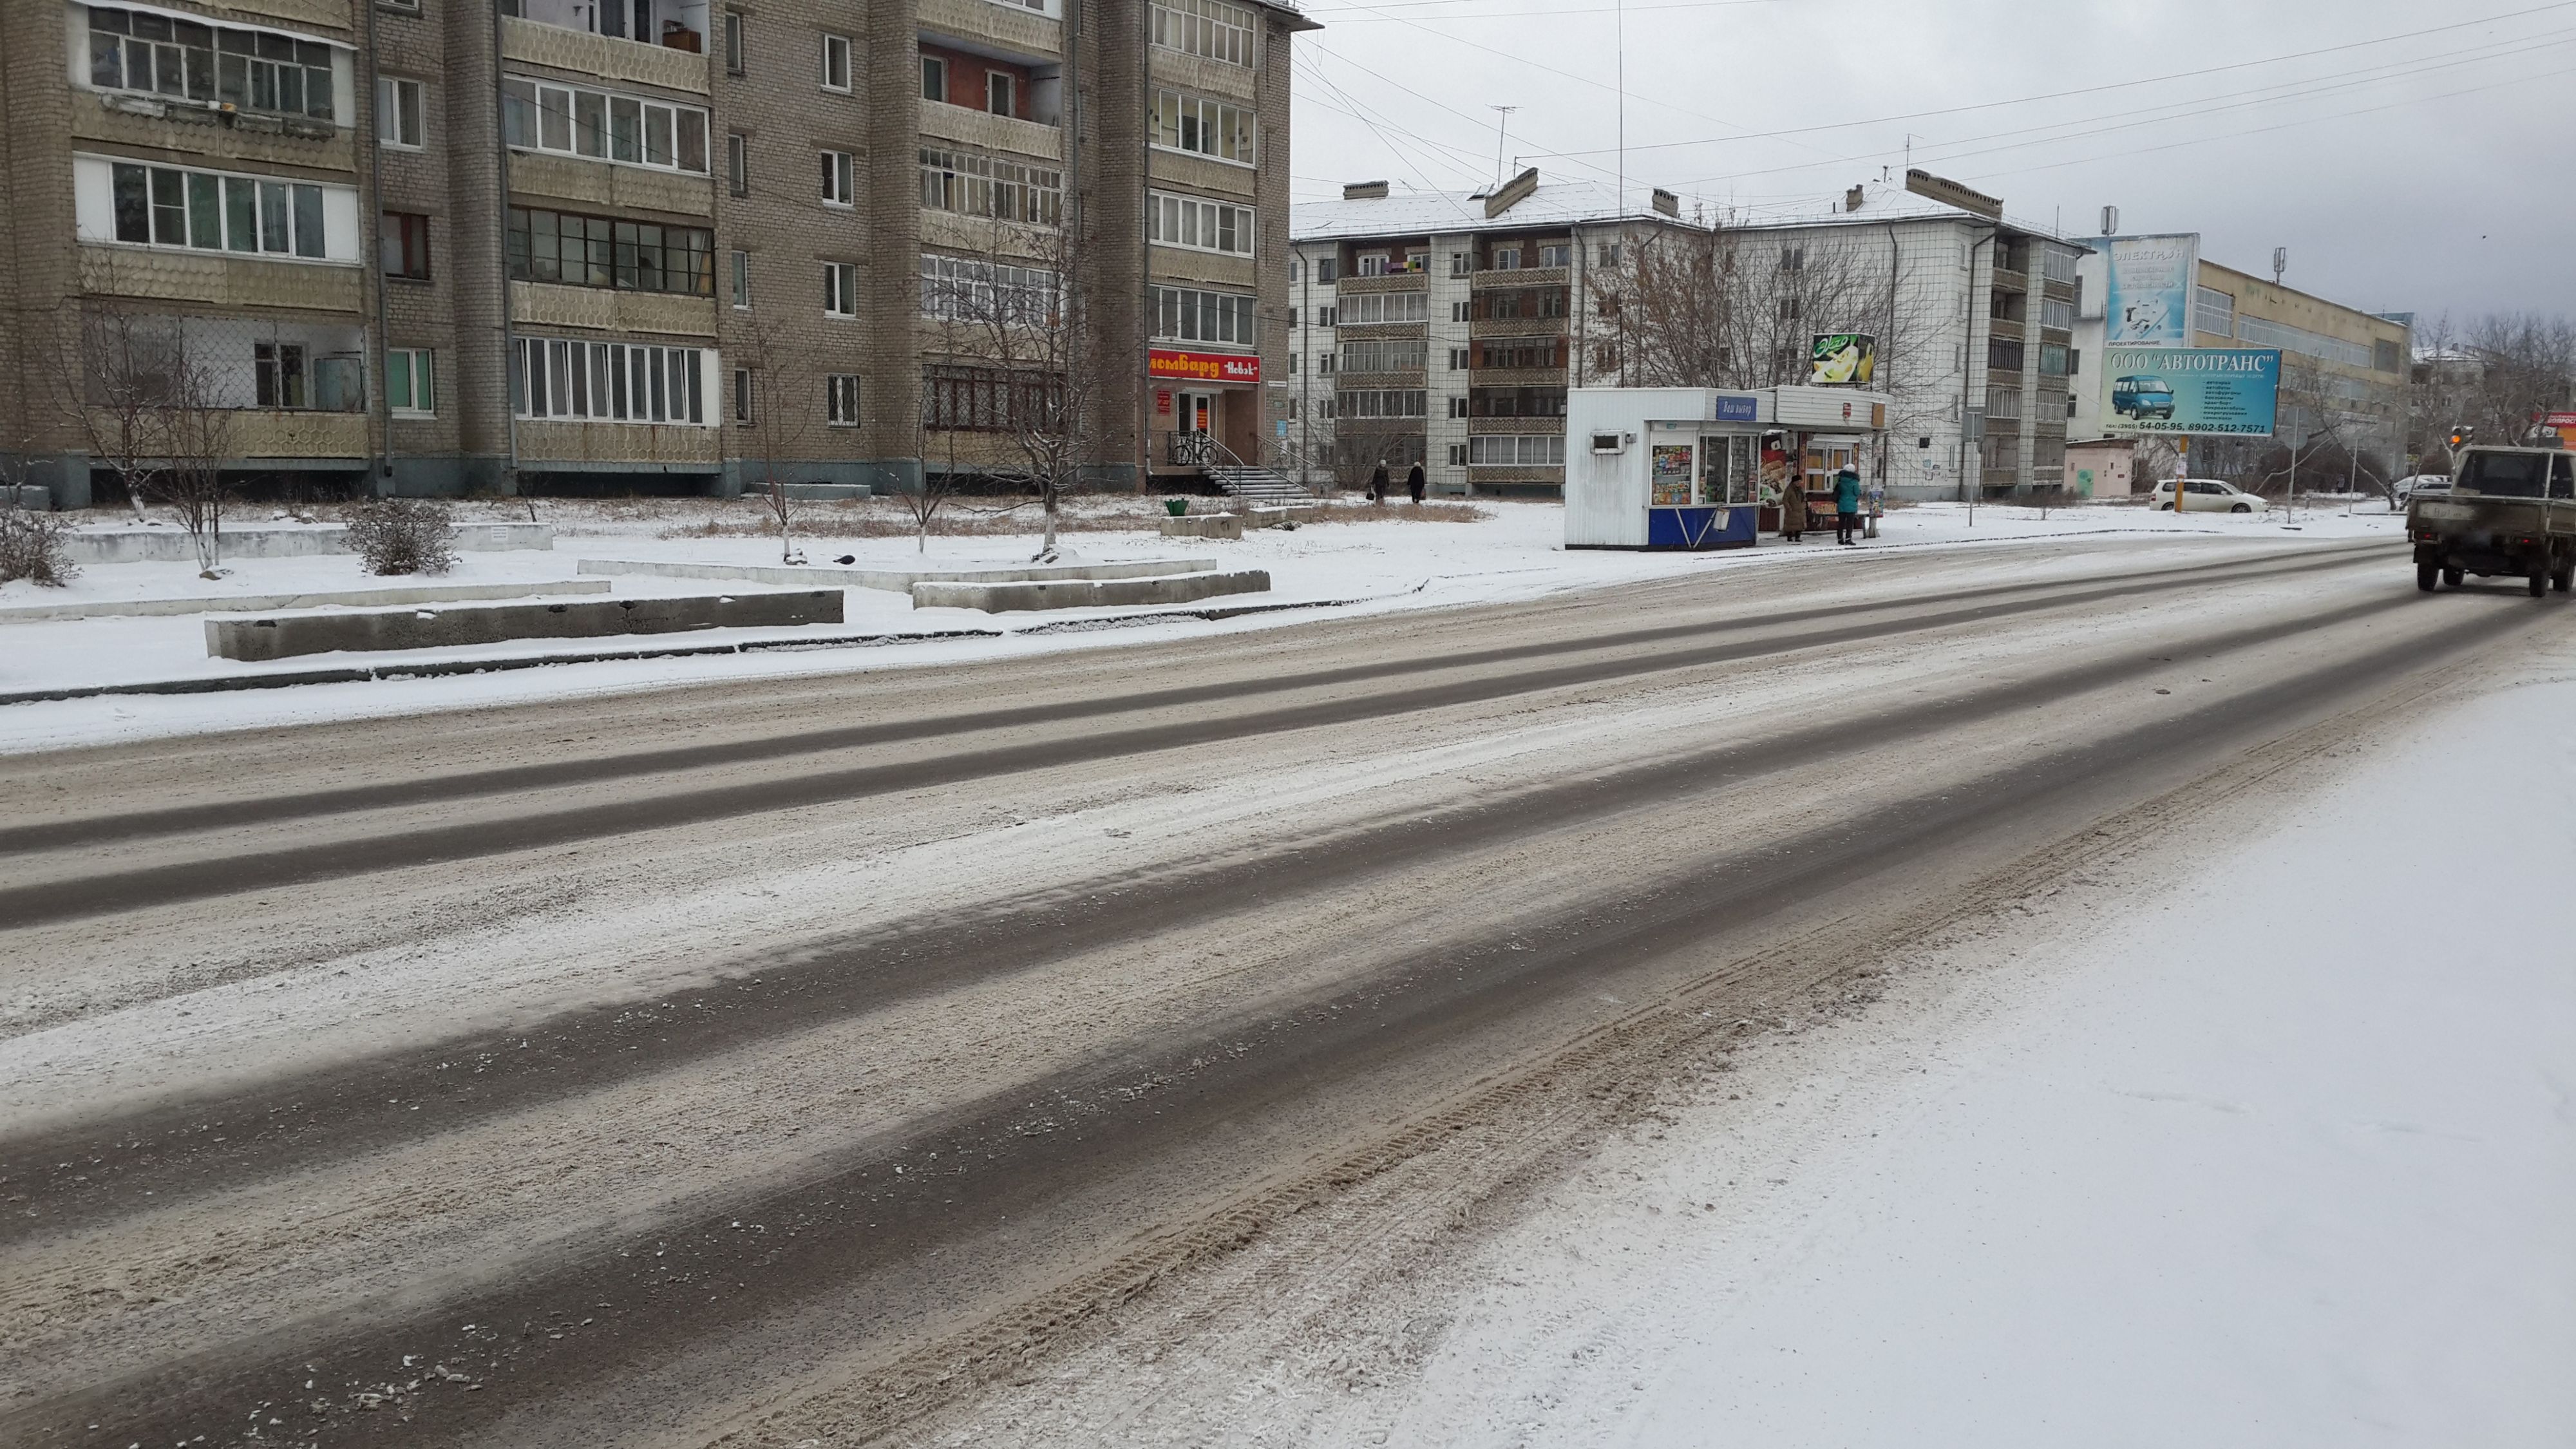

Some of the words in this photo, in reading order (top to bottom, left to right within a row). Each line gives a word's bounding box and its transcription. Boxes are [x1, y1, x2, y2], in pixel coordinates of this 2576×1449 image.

[1150, 354, 1219, 378] ломбард
[2111, 352, 2148, 370] ООО
[2152, 353, 2273, 372] “АВТОТРАНС”
[2139, 422, 2185, 431] 54-05-95,
[2188, 422, 2266, 433] 8902-512-7571
